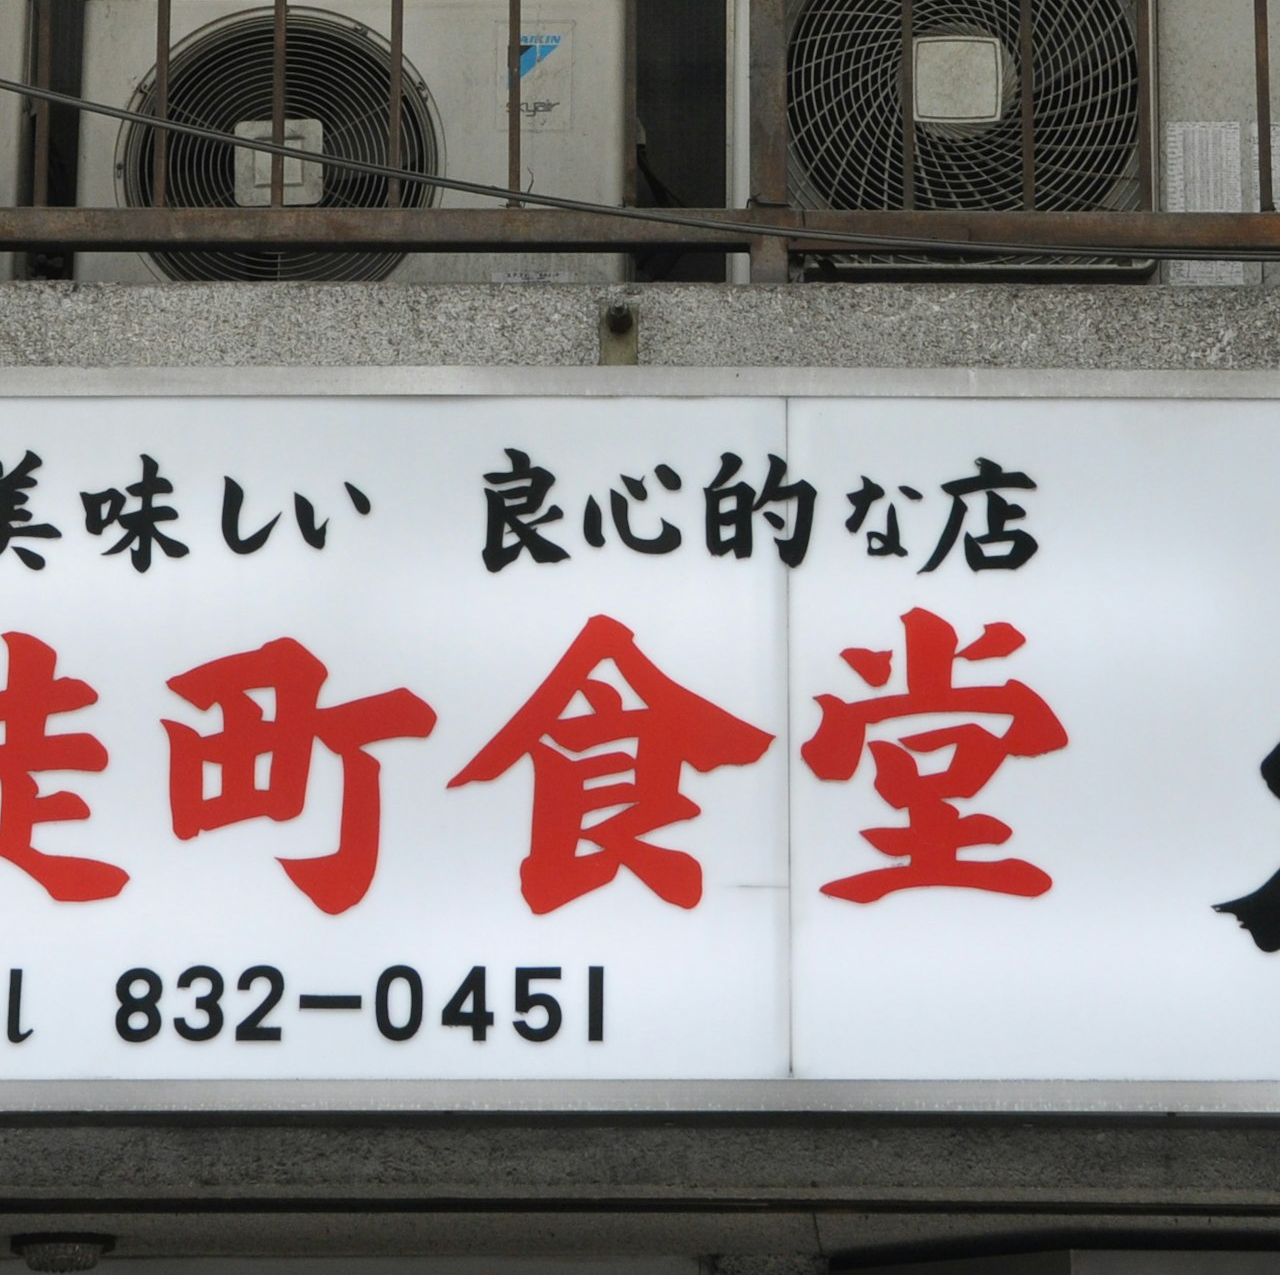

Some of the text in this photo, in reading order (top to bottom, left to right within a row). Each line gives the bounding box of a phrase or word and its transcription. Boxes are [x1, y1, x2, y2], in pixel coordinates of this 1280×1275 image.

[517, 35, 562, 44] AIKIN
[481, 448, 1039, 574] 良心的な店
[114, 965, 605, 1044] 832-0451
